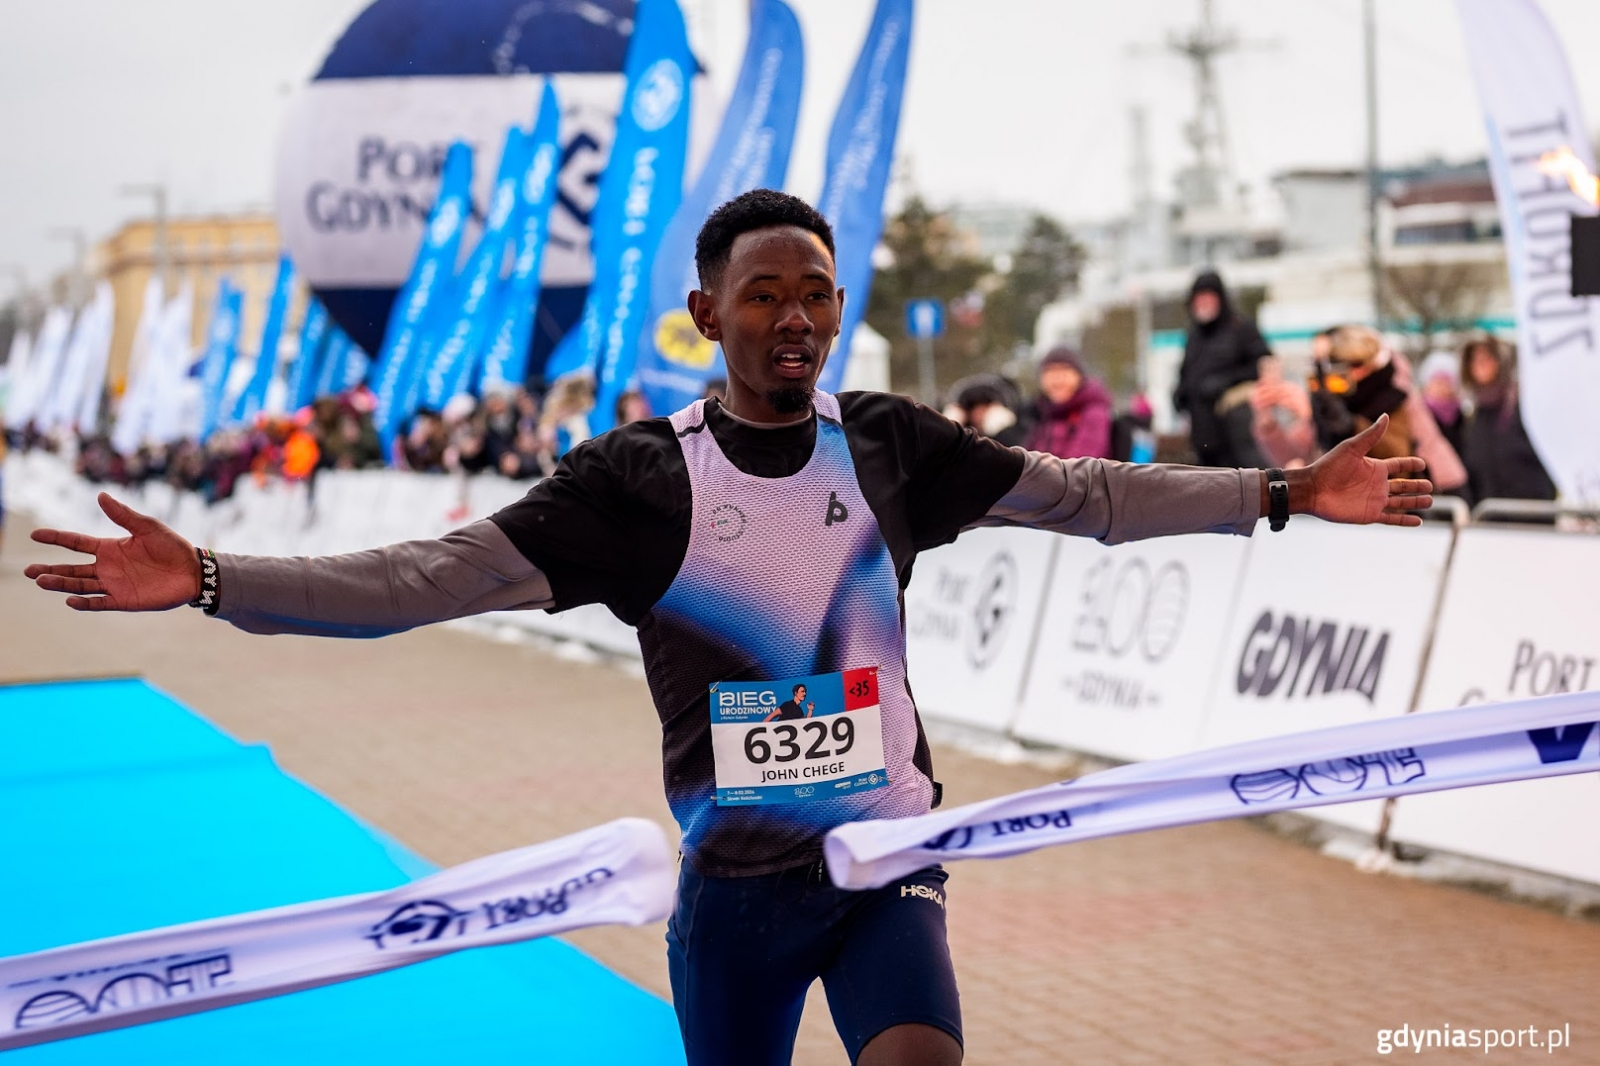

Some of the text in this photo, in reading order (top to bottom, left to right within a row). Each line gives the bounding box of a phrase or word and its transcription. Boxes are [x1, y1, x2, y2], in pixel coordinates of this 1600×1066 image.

[1236, 609, 1392, 706] GDYNIA
[1508, 637, 1597, 697] PORT
[720, 691, 777, 706] BIEG
[720, 706, 776, 715] URODZINOWY
[744, 717, 855, 764] 6329
[761, 762, 845, 783] JOHN CHEGE
[991, 809, 1073, 837] PORT
[901, 885, 943, 909] HOKA
